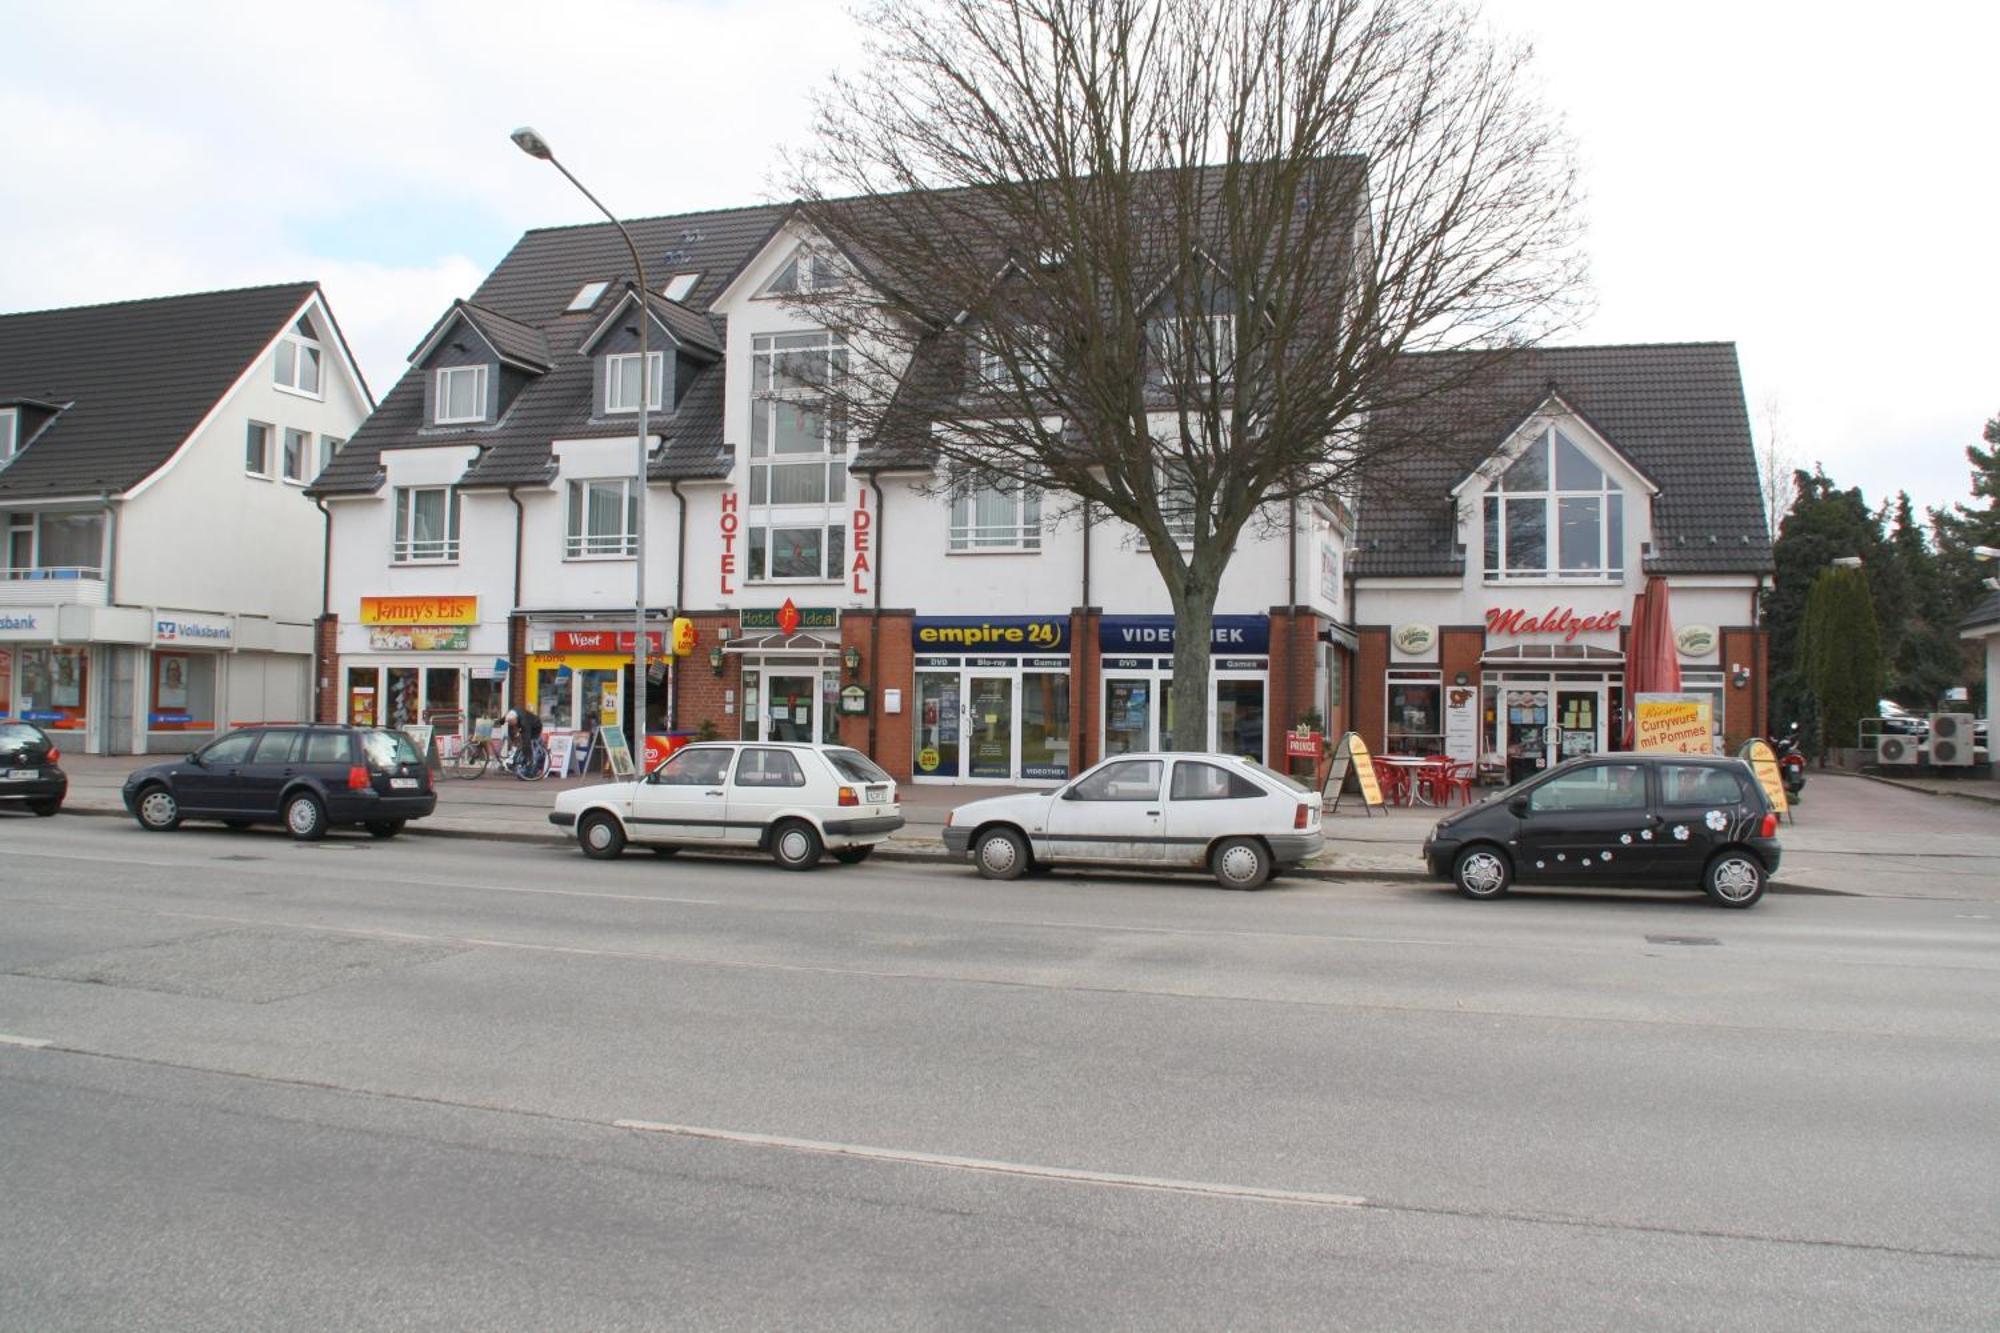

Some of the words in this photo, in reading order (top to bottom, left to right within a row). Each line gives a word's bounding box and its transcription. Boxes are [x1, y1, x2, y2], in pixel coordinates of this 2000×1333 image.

[720, 493, 738, 594] HOTEL
[853, 489, 870, 594] IDEAL
[372, 600, 433, 623] Janny's
[437, 599, 465, 619] Eis
[743, 610, 774, 625] Hotel
[803, 610, 836, 625] Ideal
[178, 623, 232, 640] Volksbank
[1485, 606, 1622, 642] Mahlzeit
[568, 632, 602, 647] West
[919, 624, 1024, 646] empire
[1027, 624, 1053, 643] 24
[1122, 628, 1244, 643] VIDEEK
[930, 658, 949, 666] DVD
[1033, 659, 1063, 667] Games
[1118, 659, 1137, 667] DVD
[1226, 660, 1257, 668] Games
[1640, 735, 1659, 749] mit
[1659, 725, 1707, 744] Pommes
[1290, 741, 1316, 752] PRINCE
